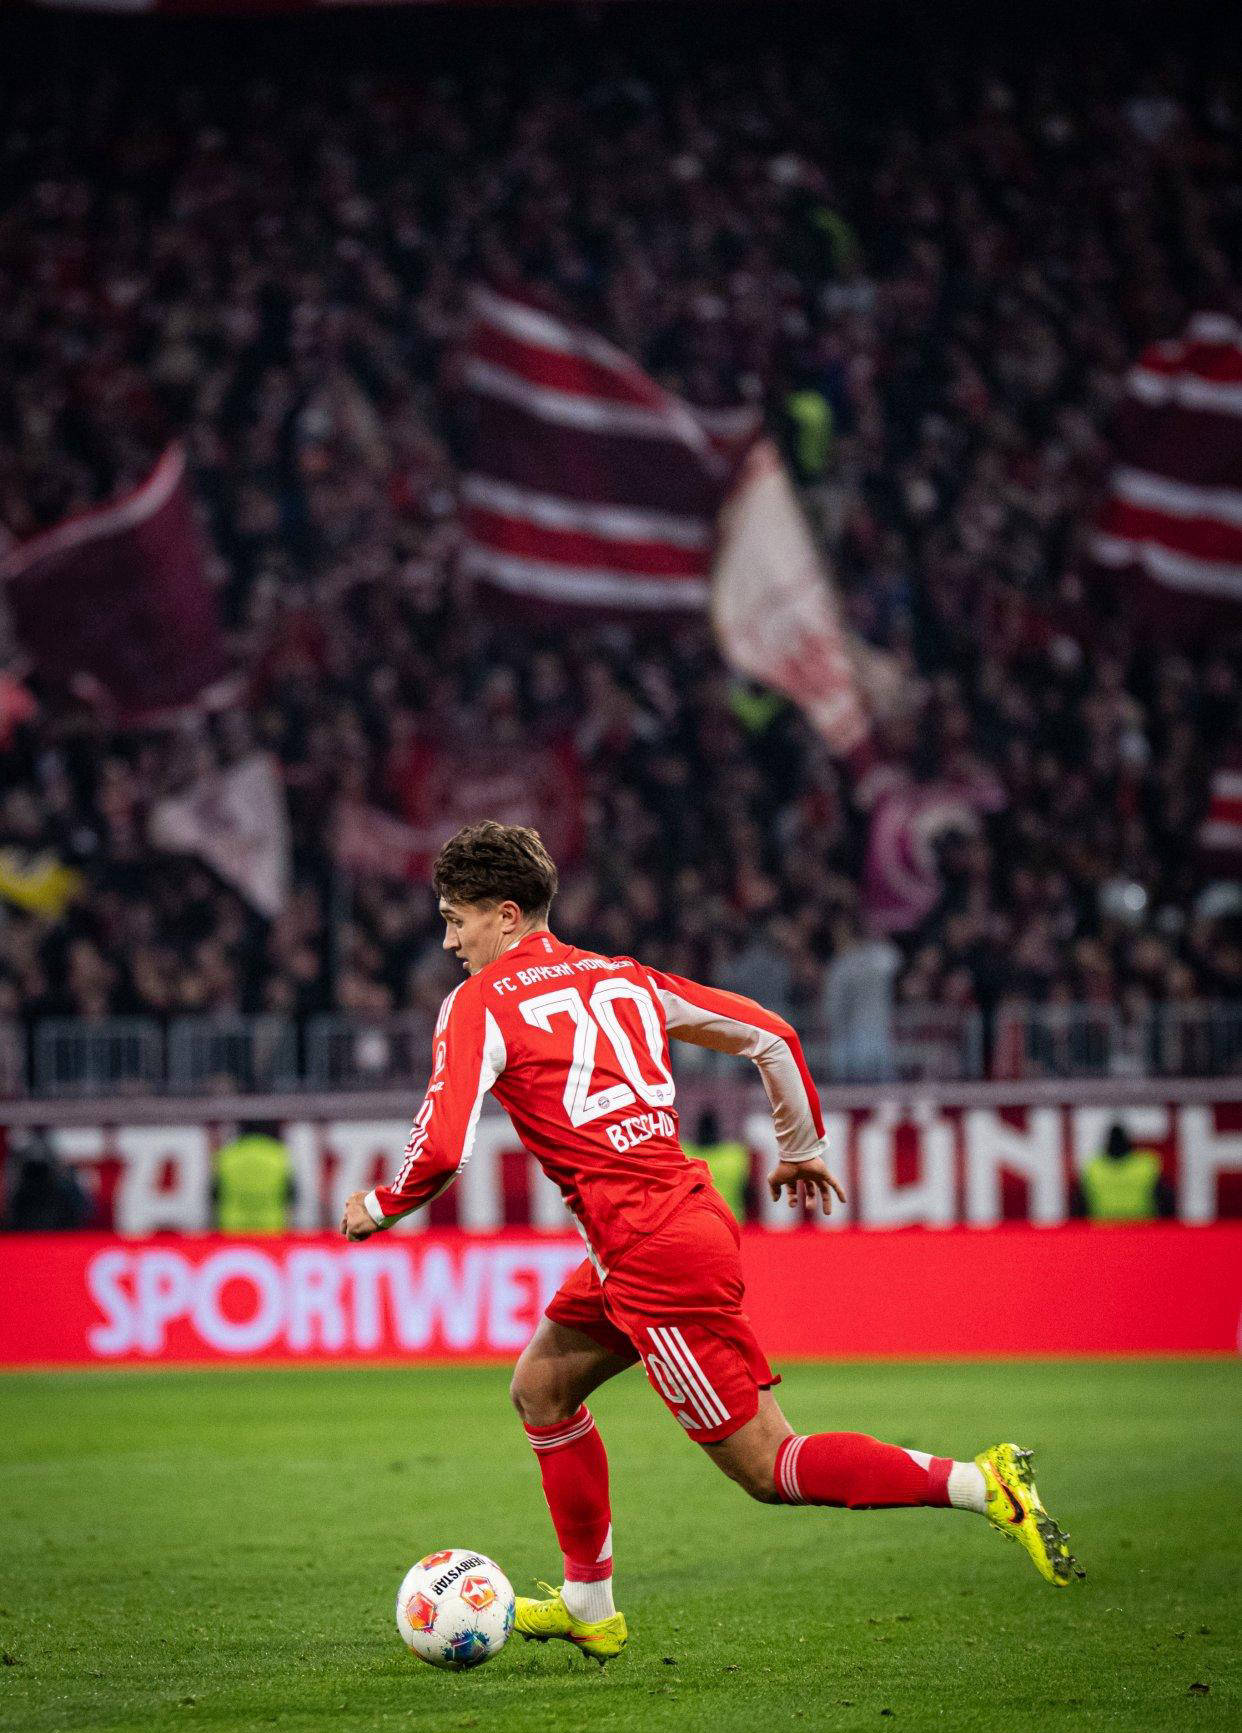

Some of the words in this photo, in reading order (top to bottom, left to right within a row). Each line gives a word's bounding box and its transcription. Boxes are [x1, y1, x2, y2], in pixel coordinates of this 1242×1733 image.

[493, 977, 517, 996] FC
[516, 962, 575, 986] BAYERN
[518, 978, 675, 1128] 20
[432, 1556, 486, 1596] DERBYSTAR
